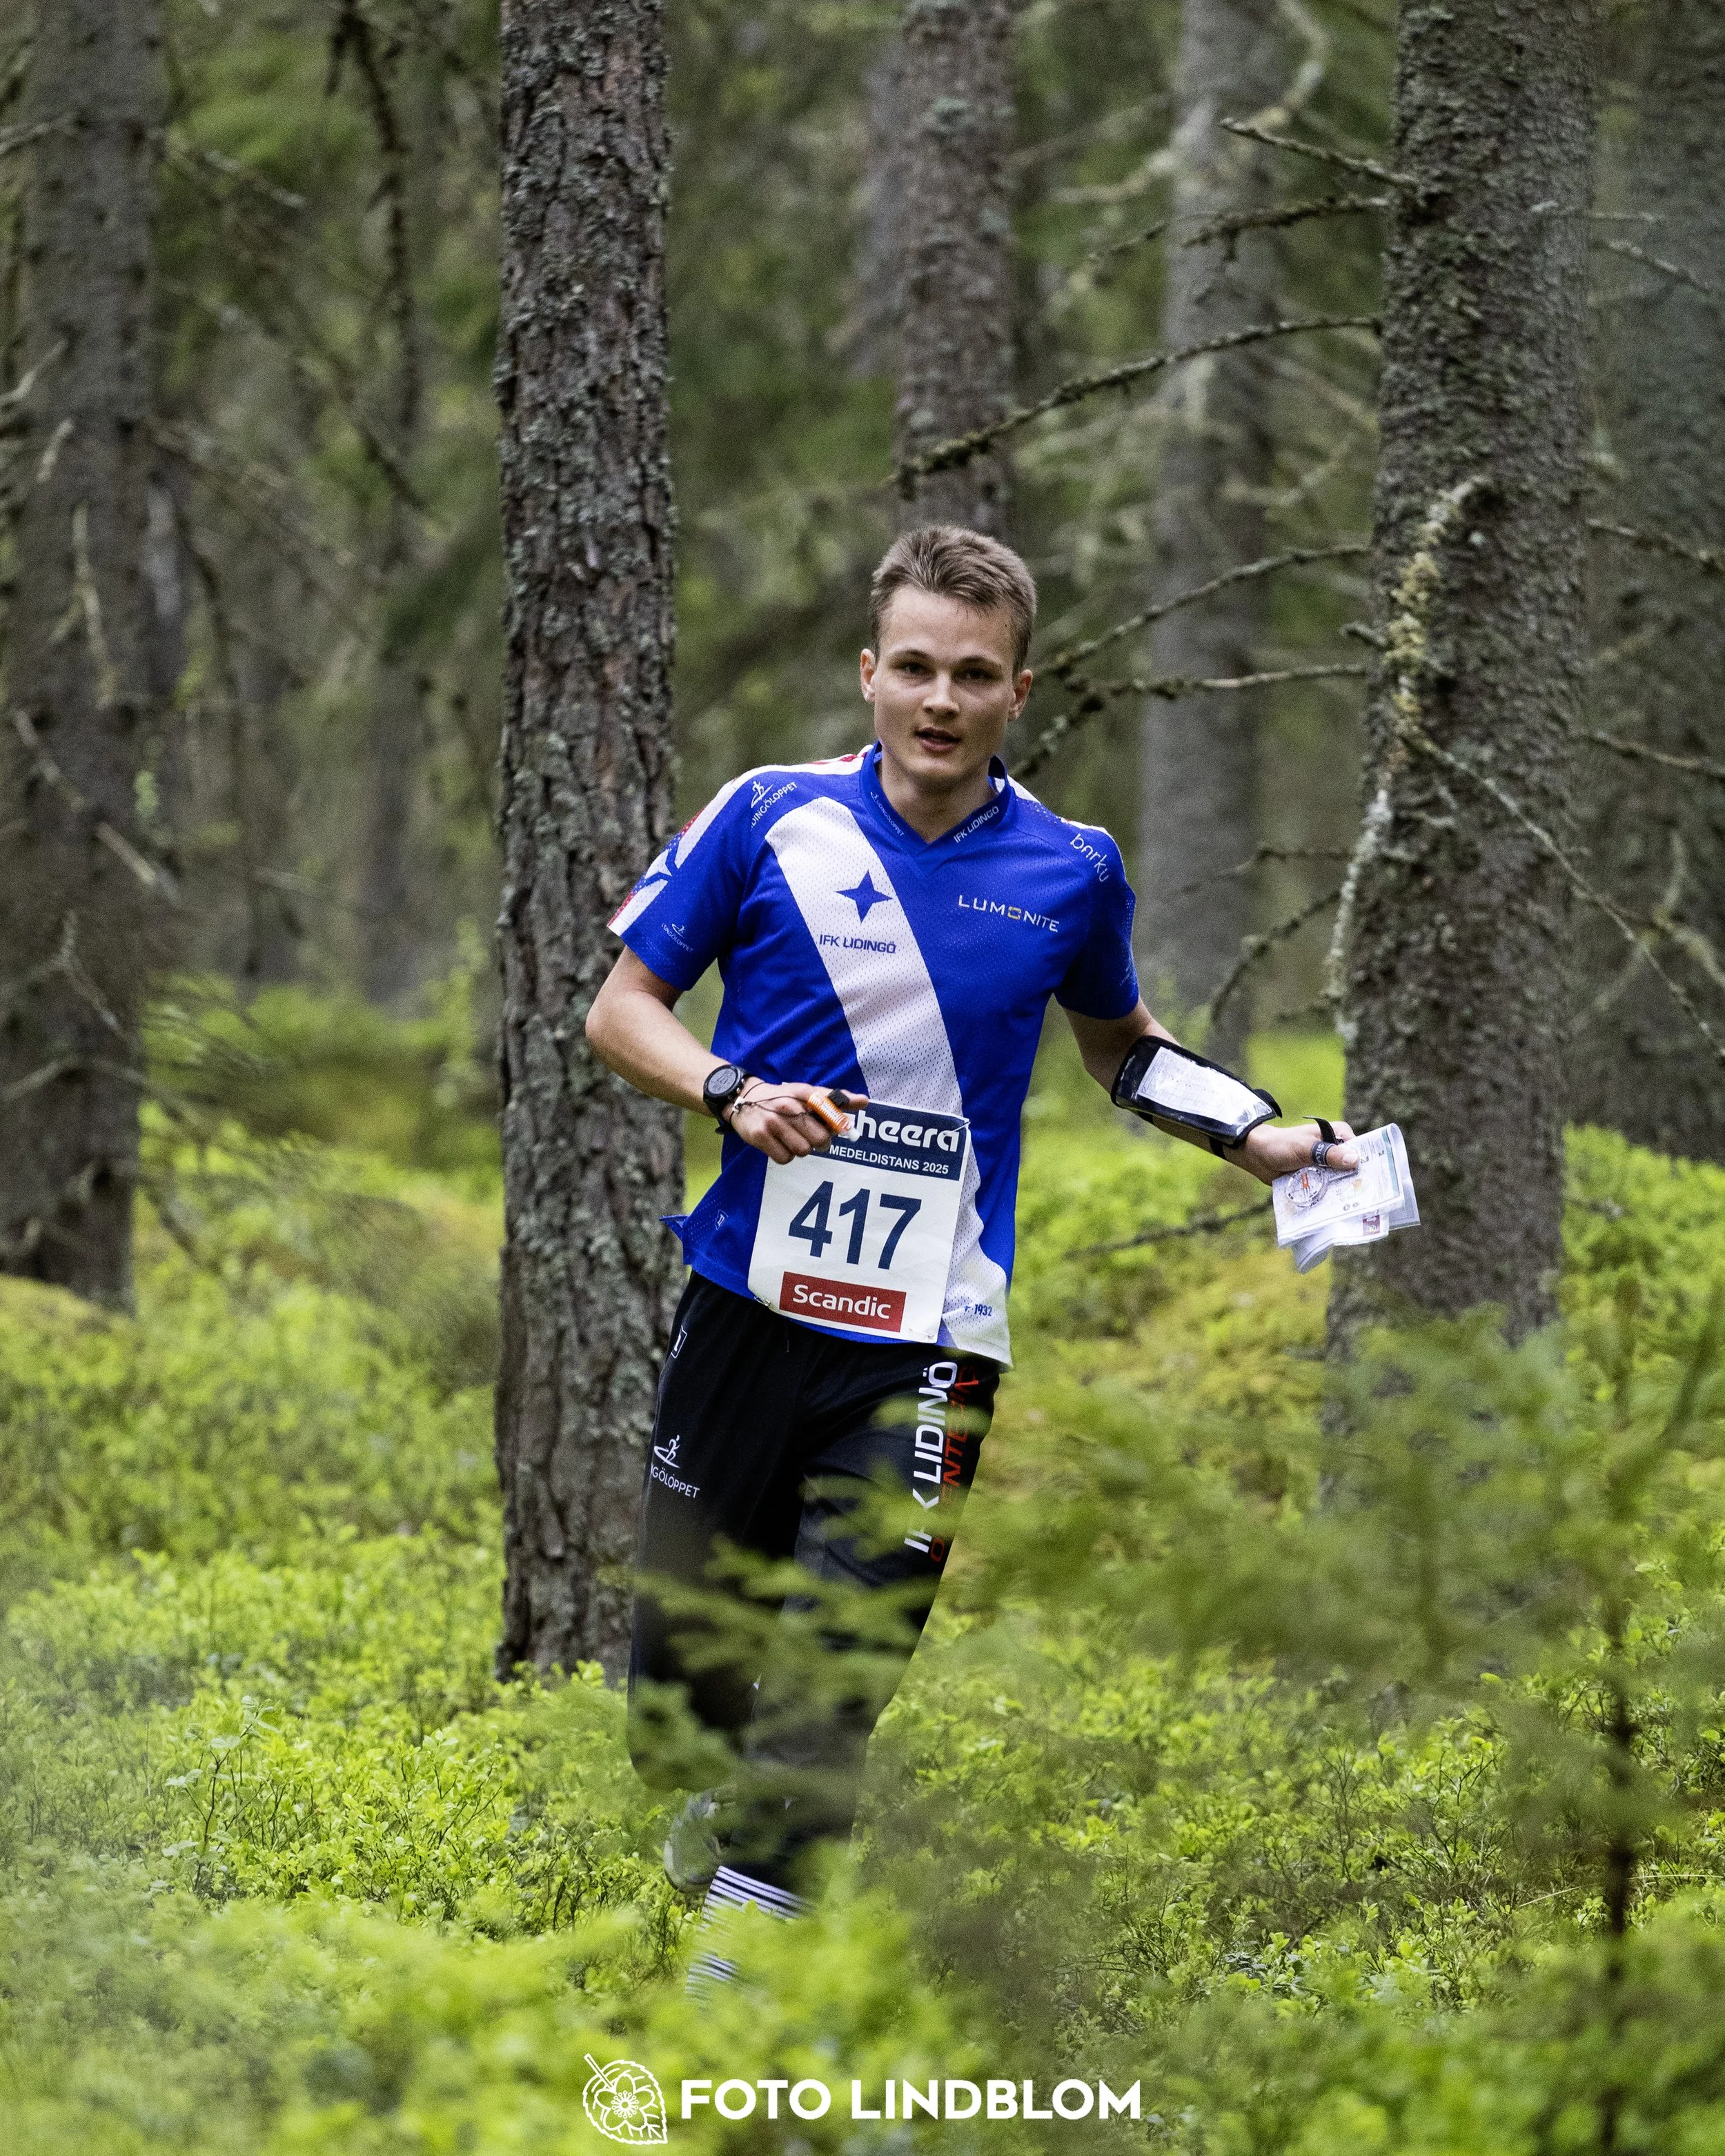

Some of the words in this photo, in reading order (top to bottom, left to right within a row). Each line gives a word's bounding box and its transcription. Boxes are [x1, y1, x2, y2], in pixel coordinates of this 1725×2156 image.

[954, 829, 967, 843] IFK
[958, 894, 1060, 933] LUMONITE
[819, 933, 840, 948] IFK
[842, 936, 897, 954] LIDINGÖ
[829, 1144, 920, 1171] MEDELDISTANS
[922, 1161, 949, 1174] 2025
[788, 1180, 922, 1270] 417
[793, 1284, 891, 1319] Scandic
[974, 1303, 993, 1317] 1932
